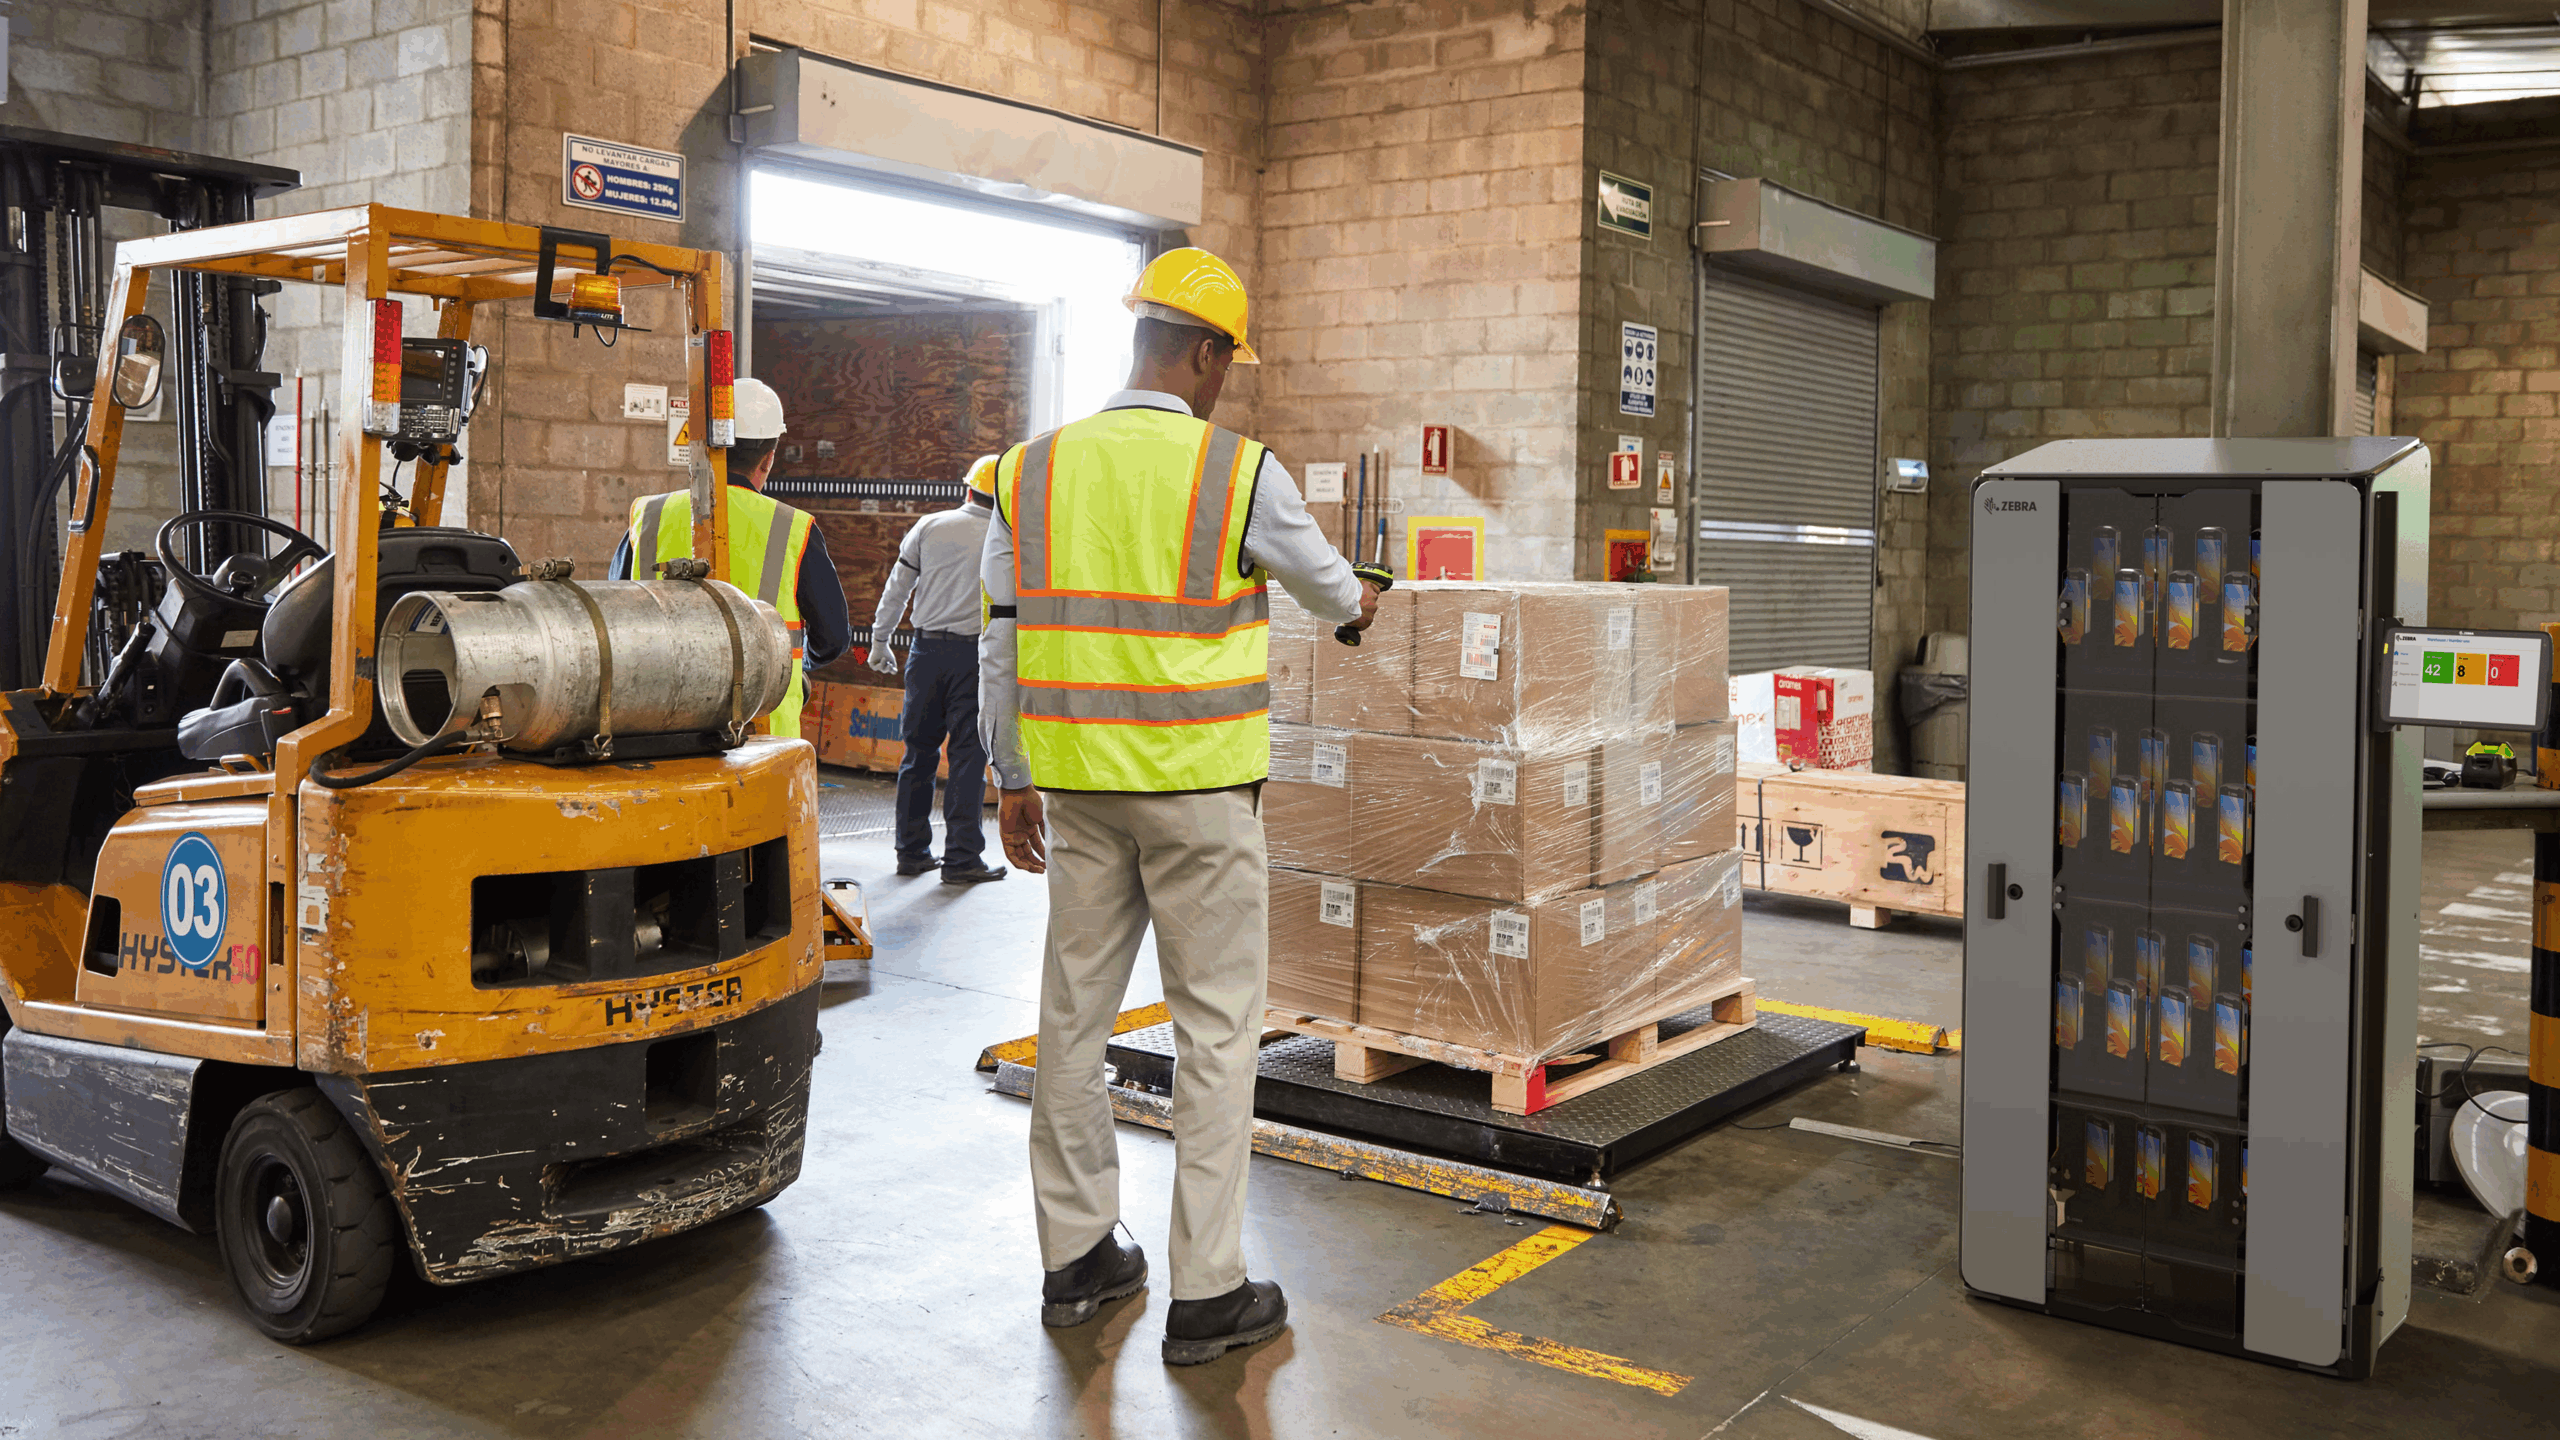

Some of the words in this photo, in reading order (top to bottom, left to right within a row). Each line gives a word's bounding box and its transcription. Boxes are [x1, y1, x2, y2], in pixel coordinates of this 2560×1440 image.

[582, 145, 594, 154] NO
[596, 148, 637, 162] LEVANTAR
[639, 155, 671, 168] CARGAS
[603, 157, 640, 171] MAYORES
[606, 174, 651, 190] HOMBRES:
[652, 183, 674, 196] 25Kg
[605, 189, 648, 204] MUJERES:
[650, 197, 678, 211] 12.5Kg
[2001, 501, 2037, 511] ZEBRA
[2425, 664, 2441, 676] 42
[2457, 665, 2466, 677] 8
[2491, 667, 2499, 678] 0
[168, 863, 220, 939] 03
[119, 932, 232, 982] HYSR
[230, 943, 262, 985] 50
